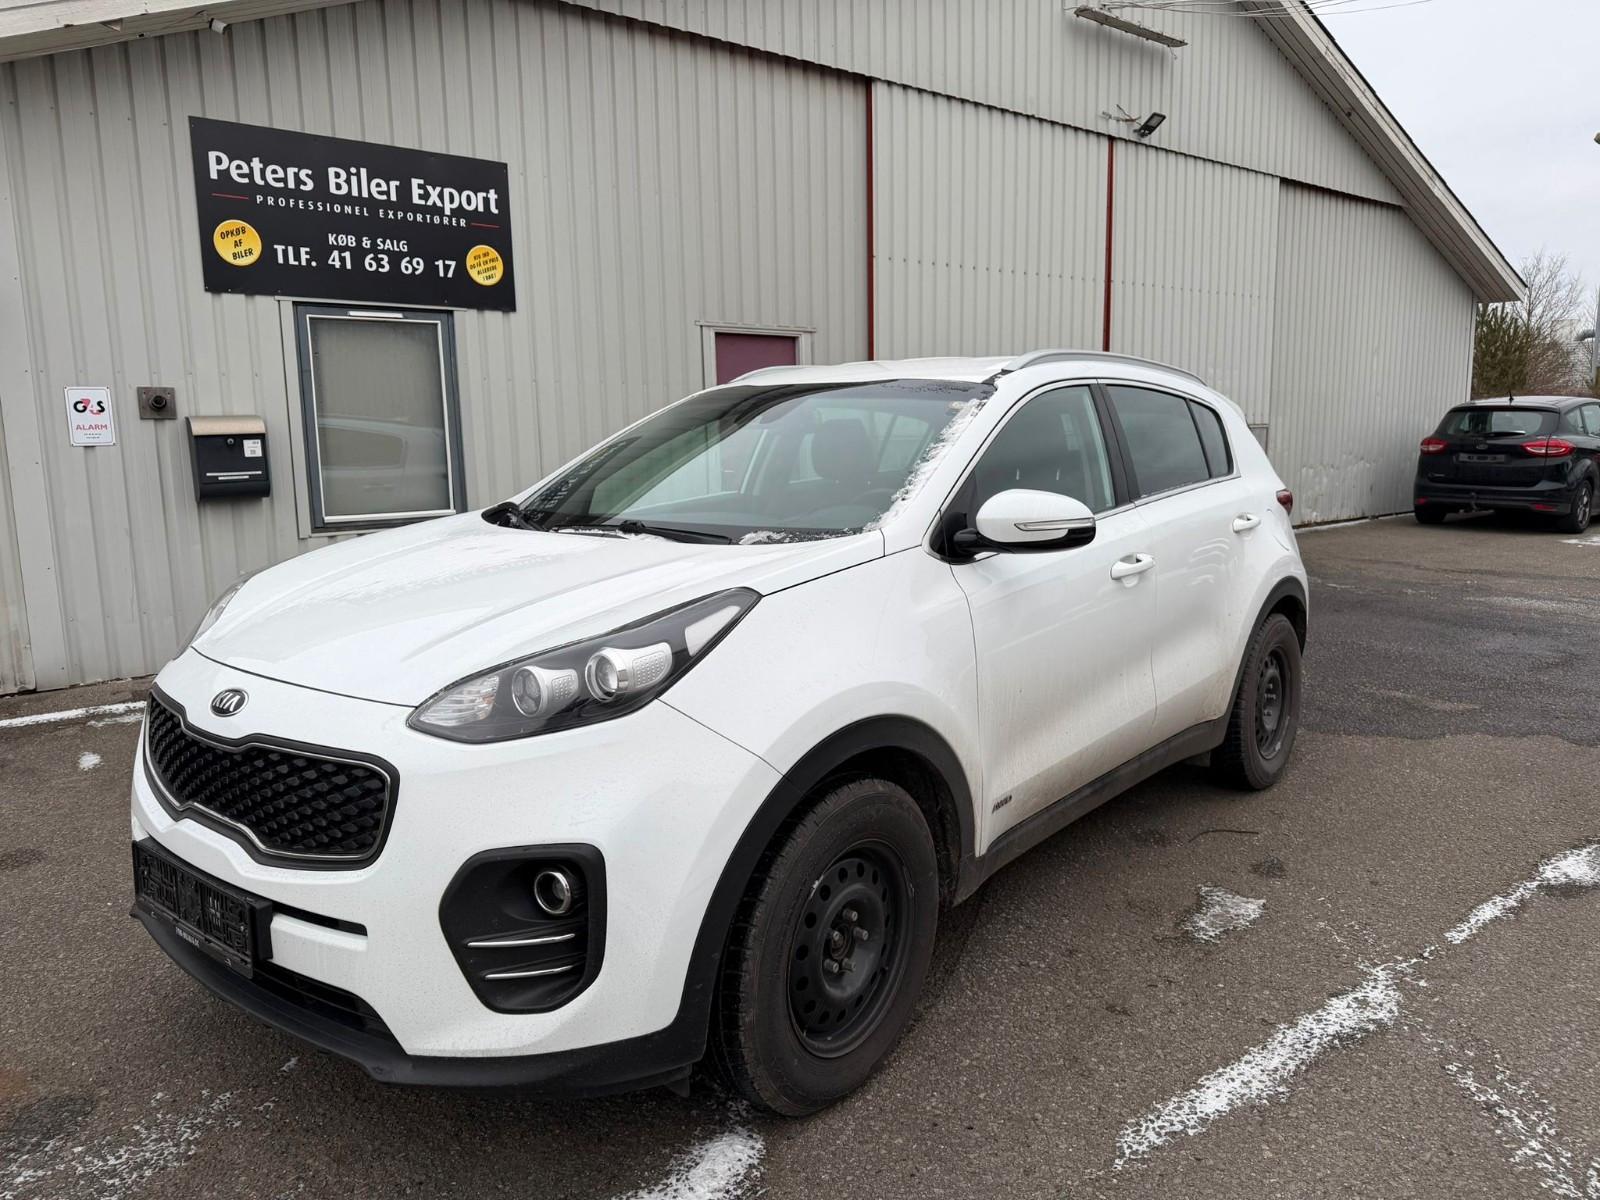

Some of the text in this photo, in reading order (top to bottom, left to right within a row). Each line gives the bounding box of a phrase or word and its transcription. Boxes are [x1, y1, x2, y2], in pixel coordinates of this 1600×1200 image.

[207, 150, 499, 216] Peters Biler Export
[256, 194, 467, 227] PROFESSIONEL EXPORTØRER
[220, 226, 246, 240] OPKØB
[233, 239, 243, 248] AF
[328, 233, 408, 252] KØB & SALG
[232, 247, 254, 260] BILER
[273, 244, 457, 278] TLF. 41 63 69 17
[73, 398, 105, 415] G4S
